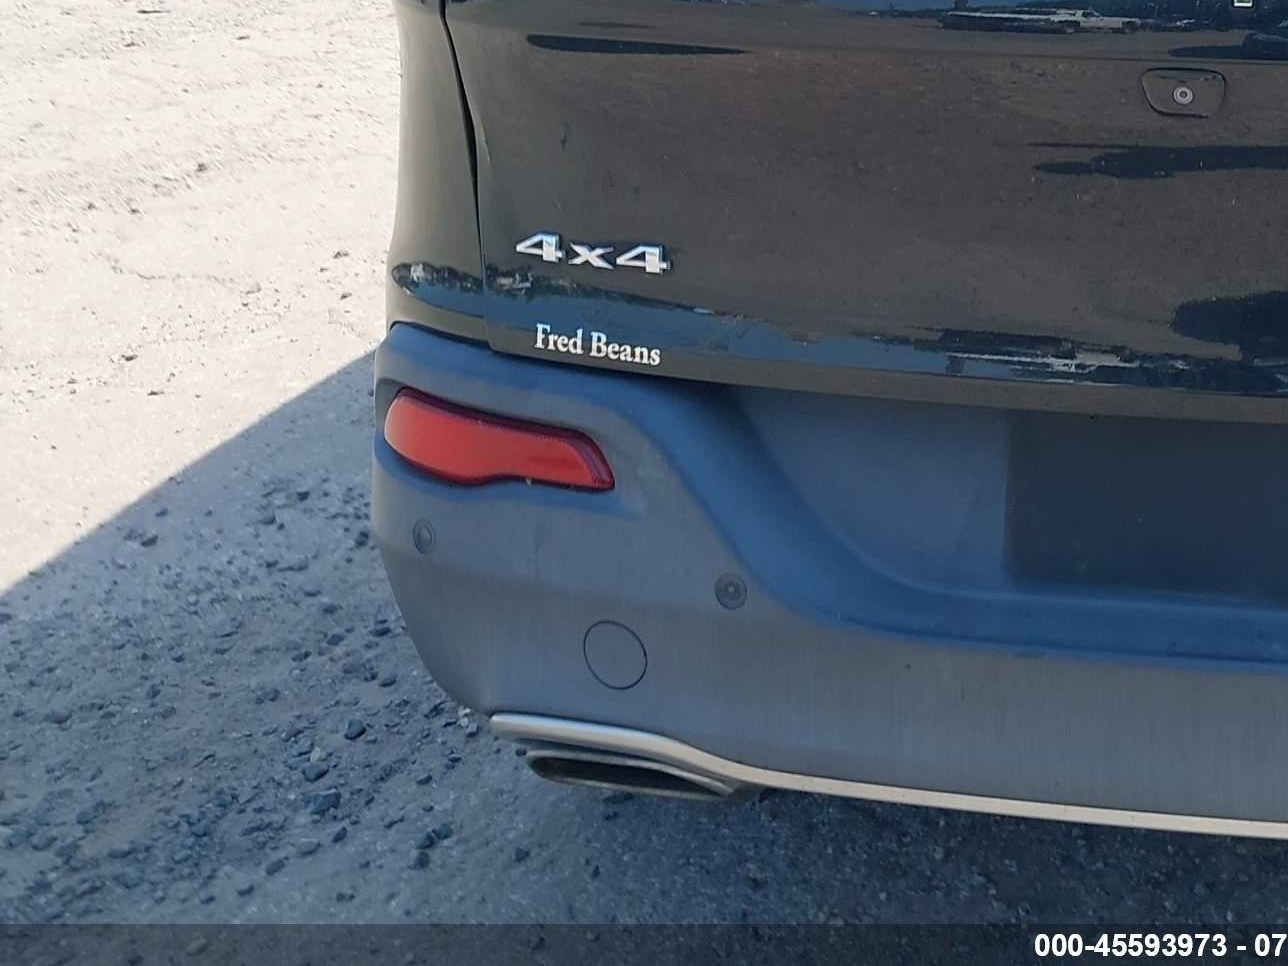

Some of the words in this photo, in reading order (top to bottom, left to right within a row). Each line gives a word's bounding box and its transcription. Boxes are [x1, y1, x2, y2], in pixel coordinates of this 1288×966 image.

[515, 233, 672, 275] 4x4
[534, 322, 584, 355] Fred
[589, 331, 662, 366] Beans
